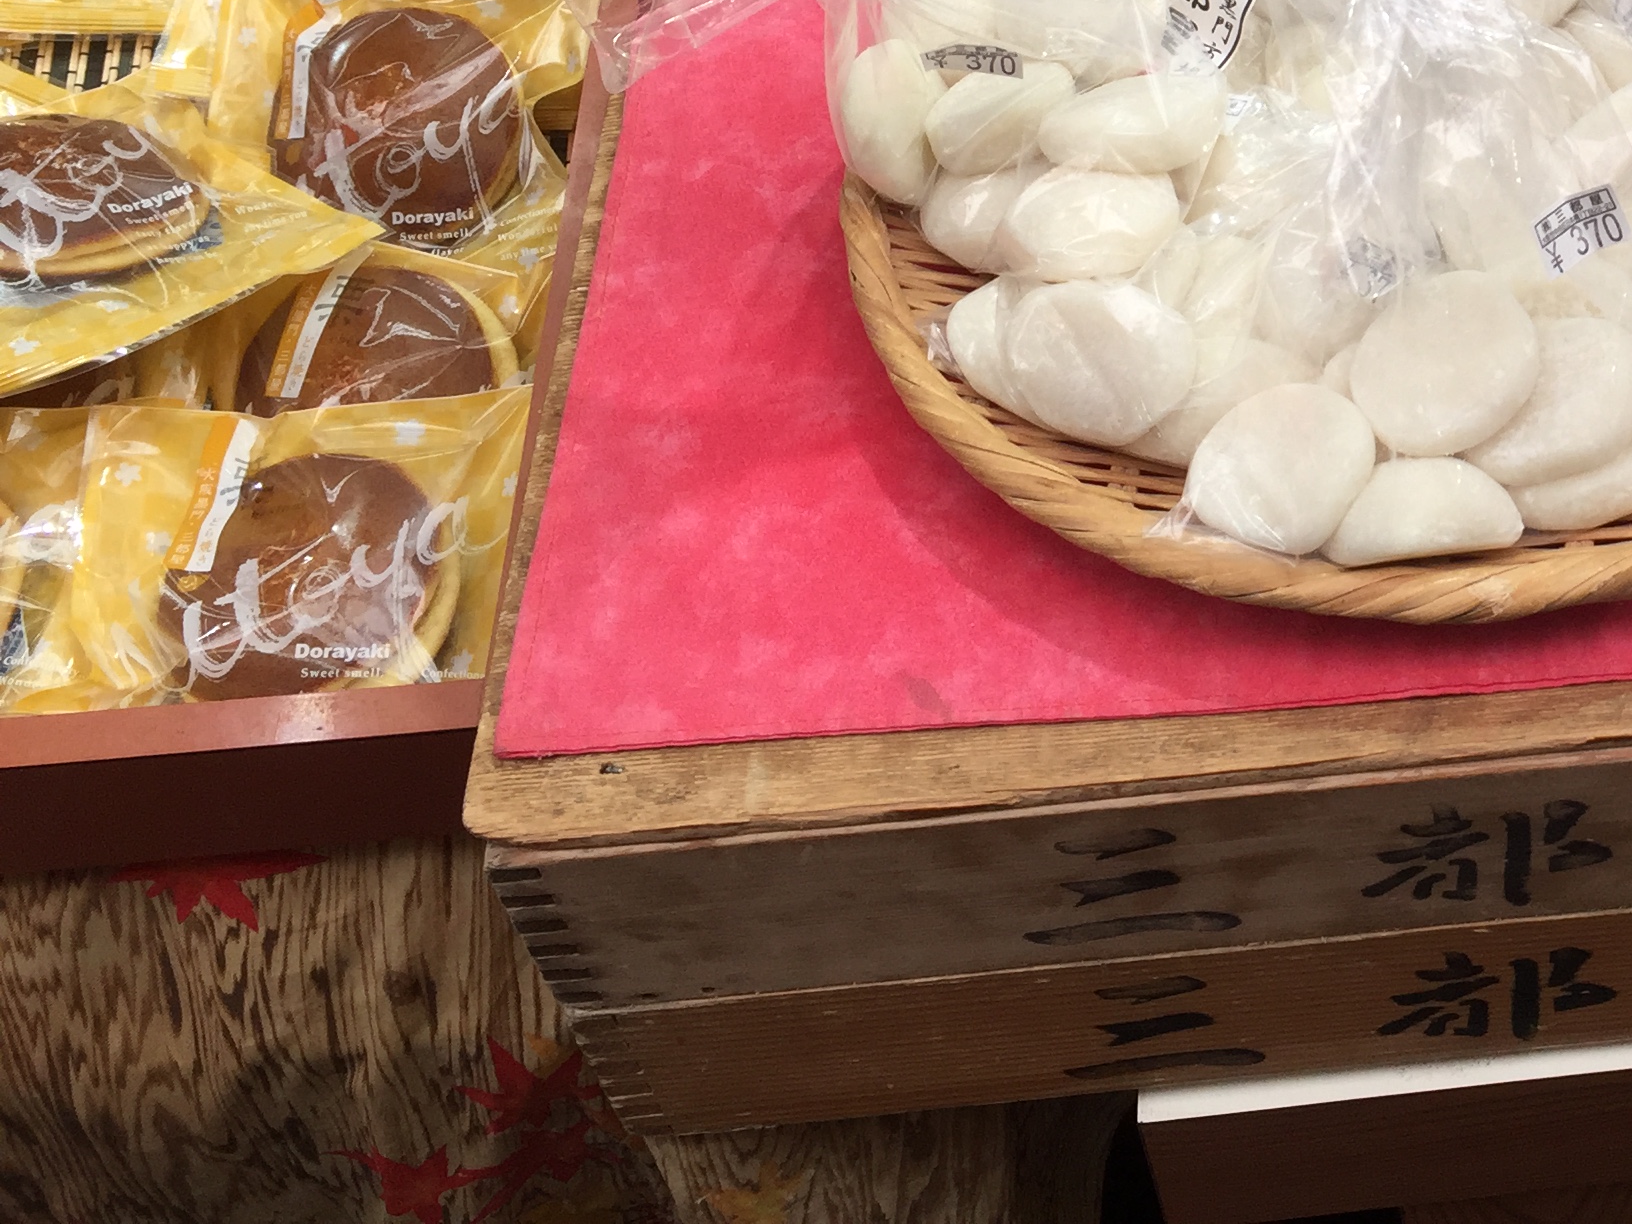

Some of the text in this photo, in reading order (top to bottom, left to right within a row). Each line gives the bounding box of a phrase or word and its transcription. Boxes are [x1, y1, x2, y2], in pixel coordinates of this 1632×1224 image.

[107, 182, 193, 214] Dorayaki
[392, 208, 475, 226] Dorayaki
[400, 231, 434, 241] Sweet
[294, 643, 391, 661] Dorayaki
[300, 667, 341, 678] Sweet
